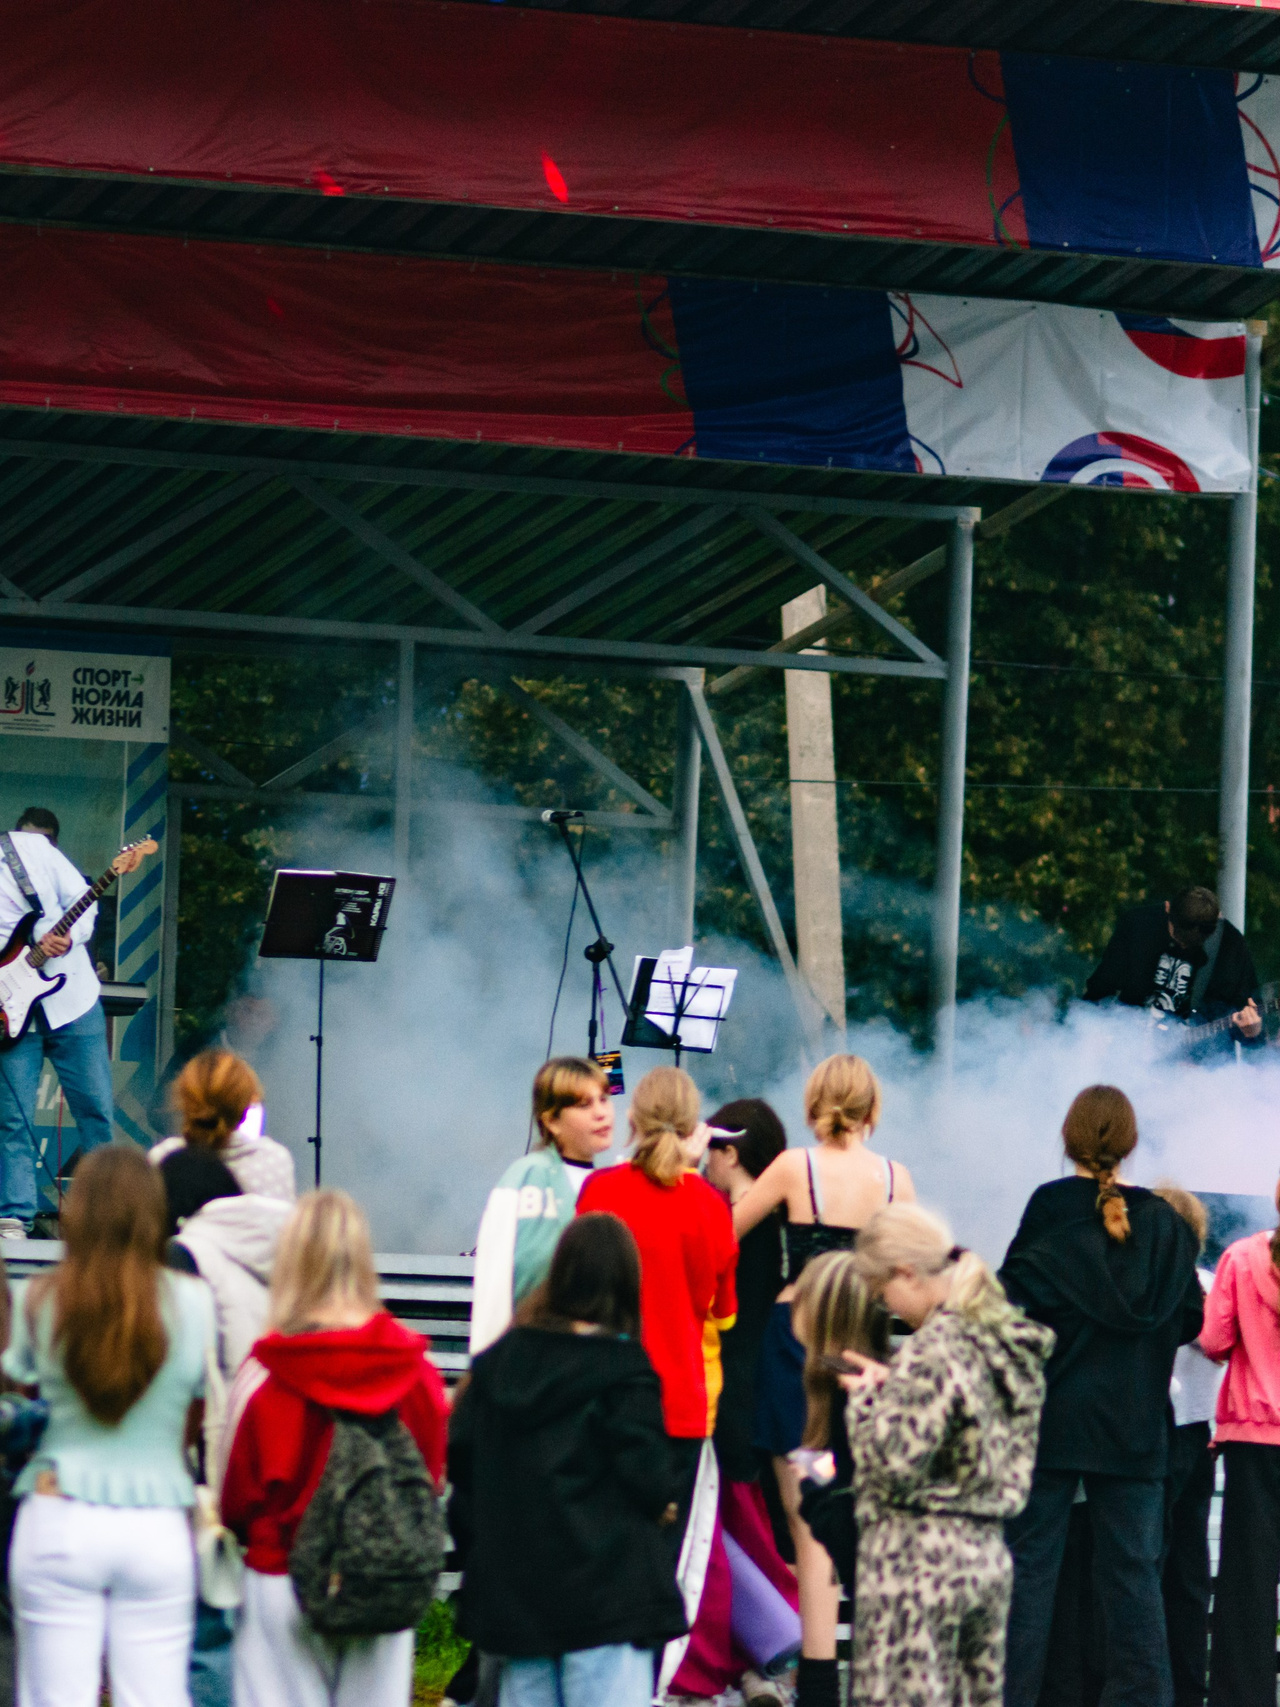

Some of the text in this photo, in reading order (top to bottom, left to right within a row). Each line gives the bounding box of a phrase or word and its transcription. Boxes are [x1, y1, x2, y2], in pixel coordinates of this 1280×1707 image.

[73, 667, 132, 687] СПОРТ
[72, 687, 144, 708] НОРМА
[71, 706, 142, 728] ЖИЗНИ
